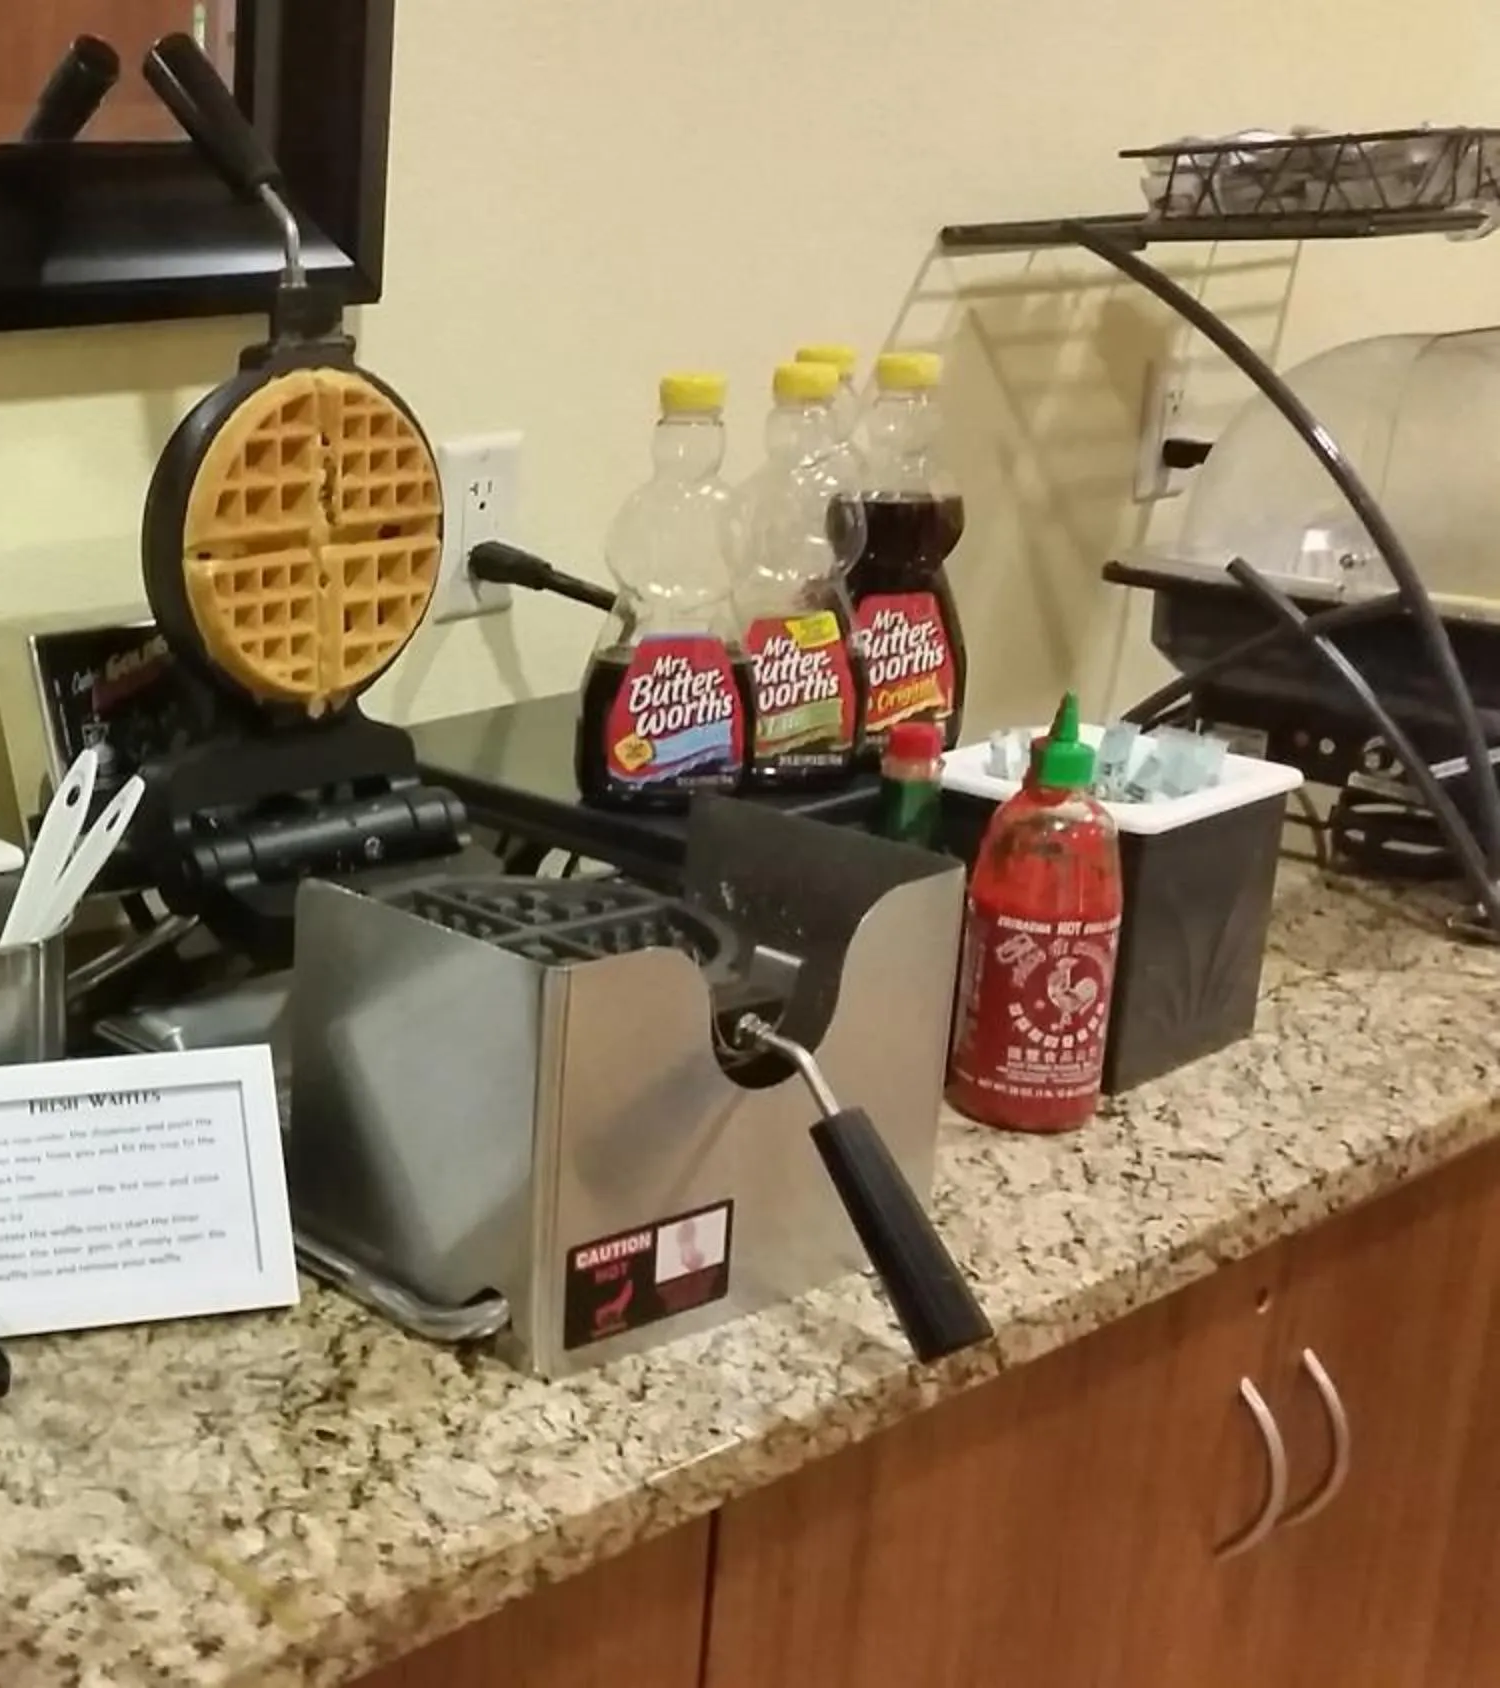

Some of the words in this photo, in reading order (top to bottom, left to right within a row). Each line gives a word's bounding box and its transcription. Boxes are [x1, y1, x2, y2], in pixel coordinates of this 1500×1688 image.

[636, 690, 733, 737] worth's
[1057, 921, 1082, 936] HOT
[575, 1231, 652, 1271] CAUTION
[593, 1261, 630, 1285] HOT
